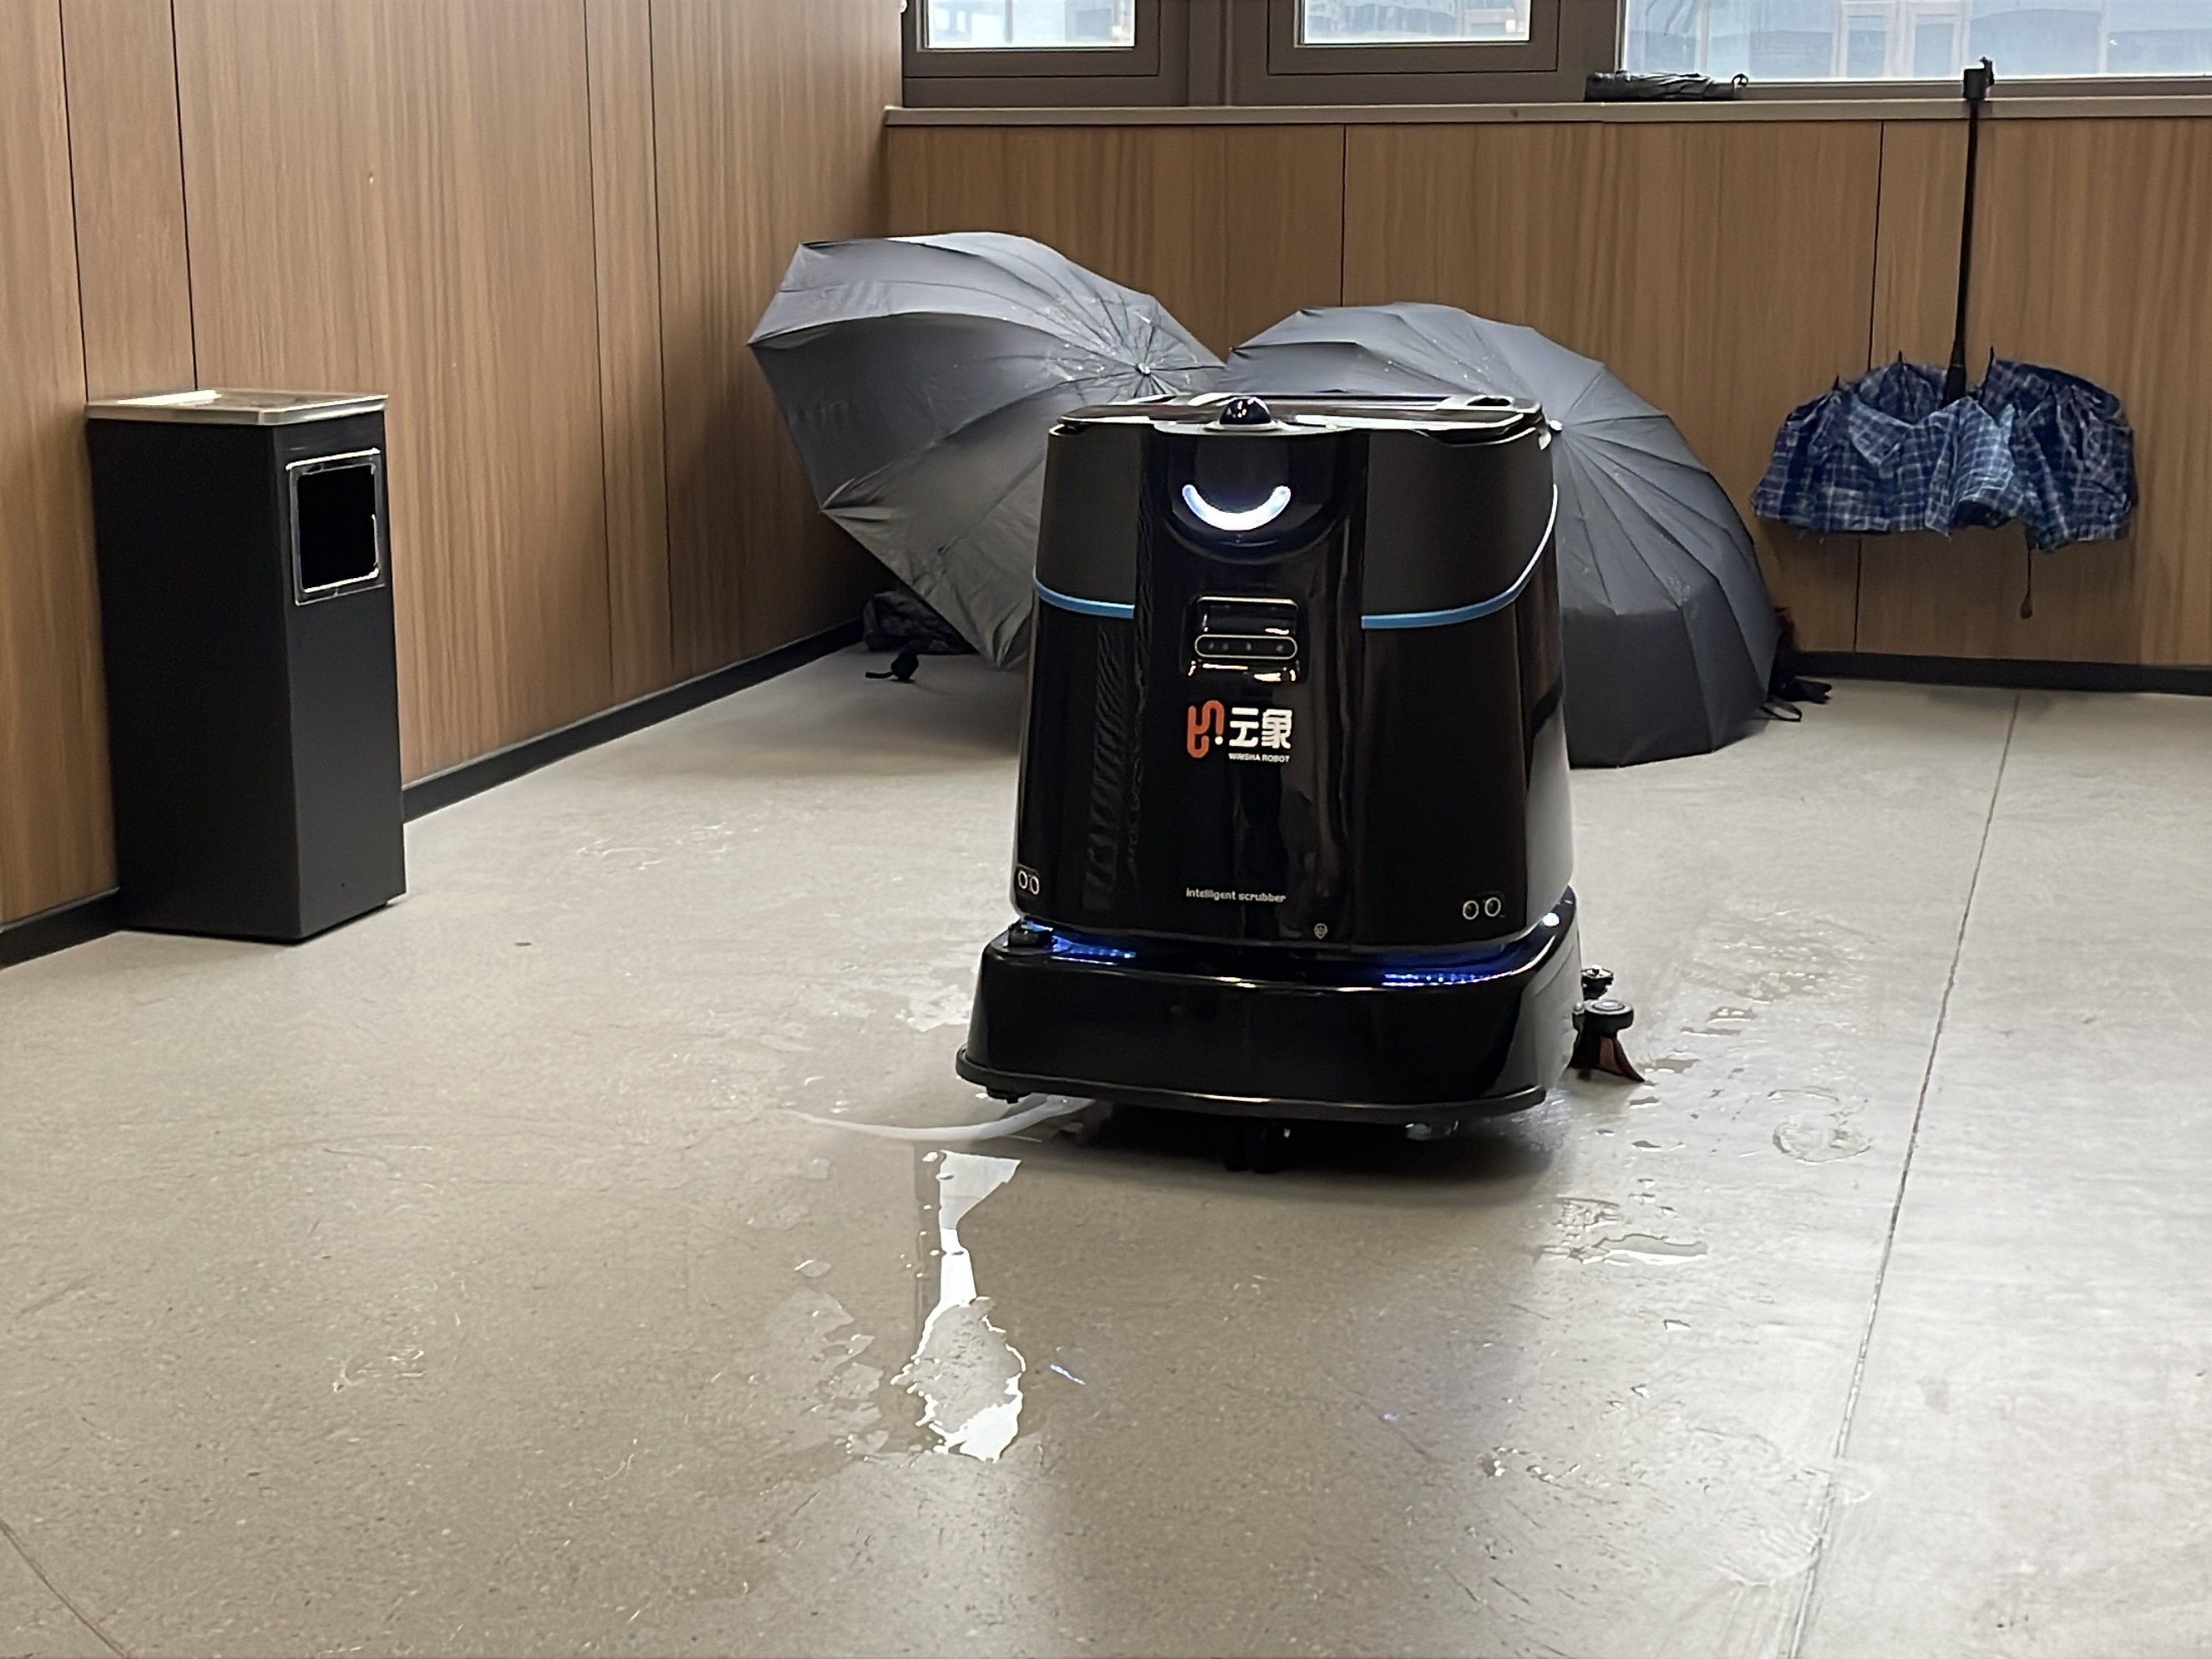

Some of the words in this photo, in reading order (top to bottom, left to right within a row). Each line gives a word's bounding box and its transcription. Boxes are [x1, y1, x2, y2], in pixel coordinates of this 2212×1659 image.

[1229, 707, 1292, 748] 云象
[1261, 753, 1290, 763] ROBOT
[1238, 892, 1286, 902] scrubber
